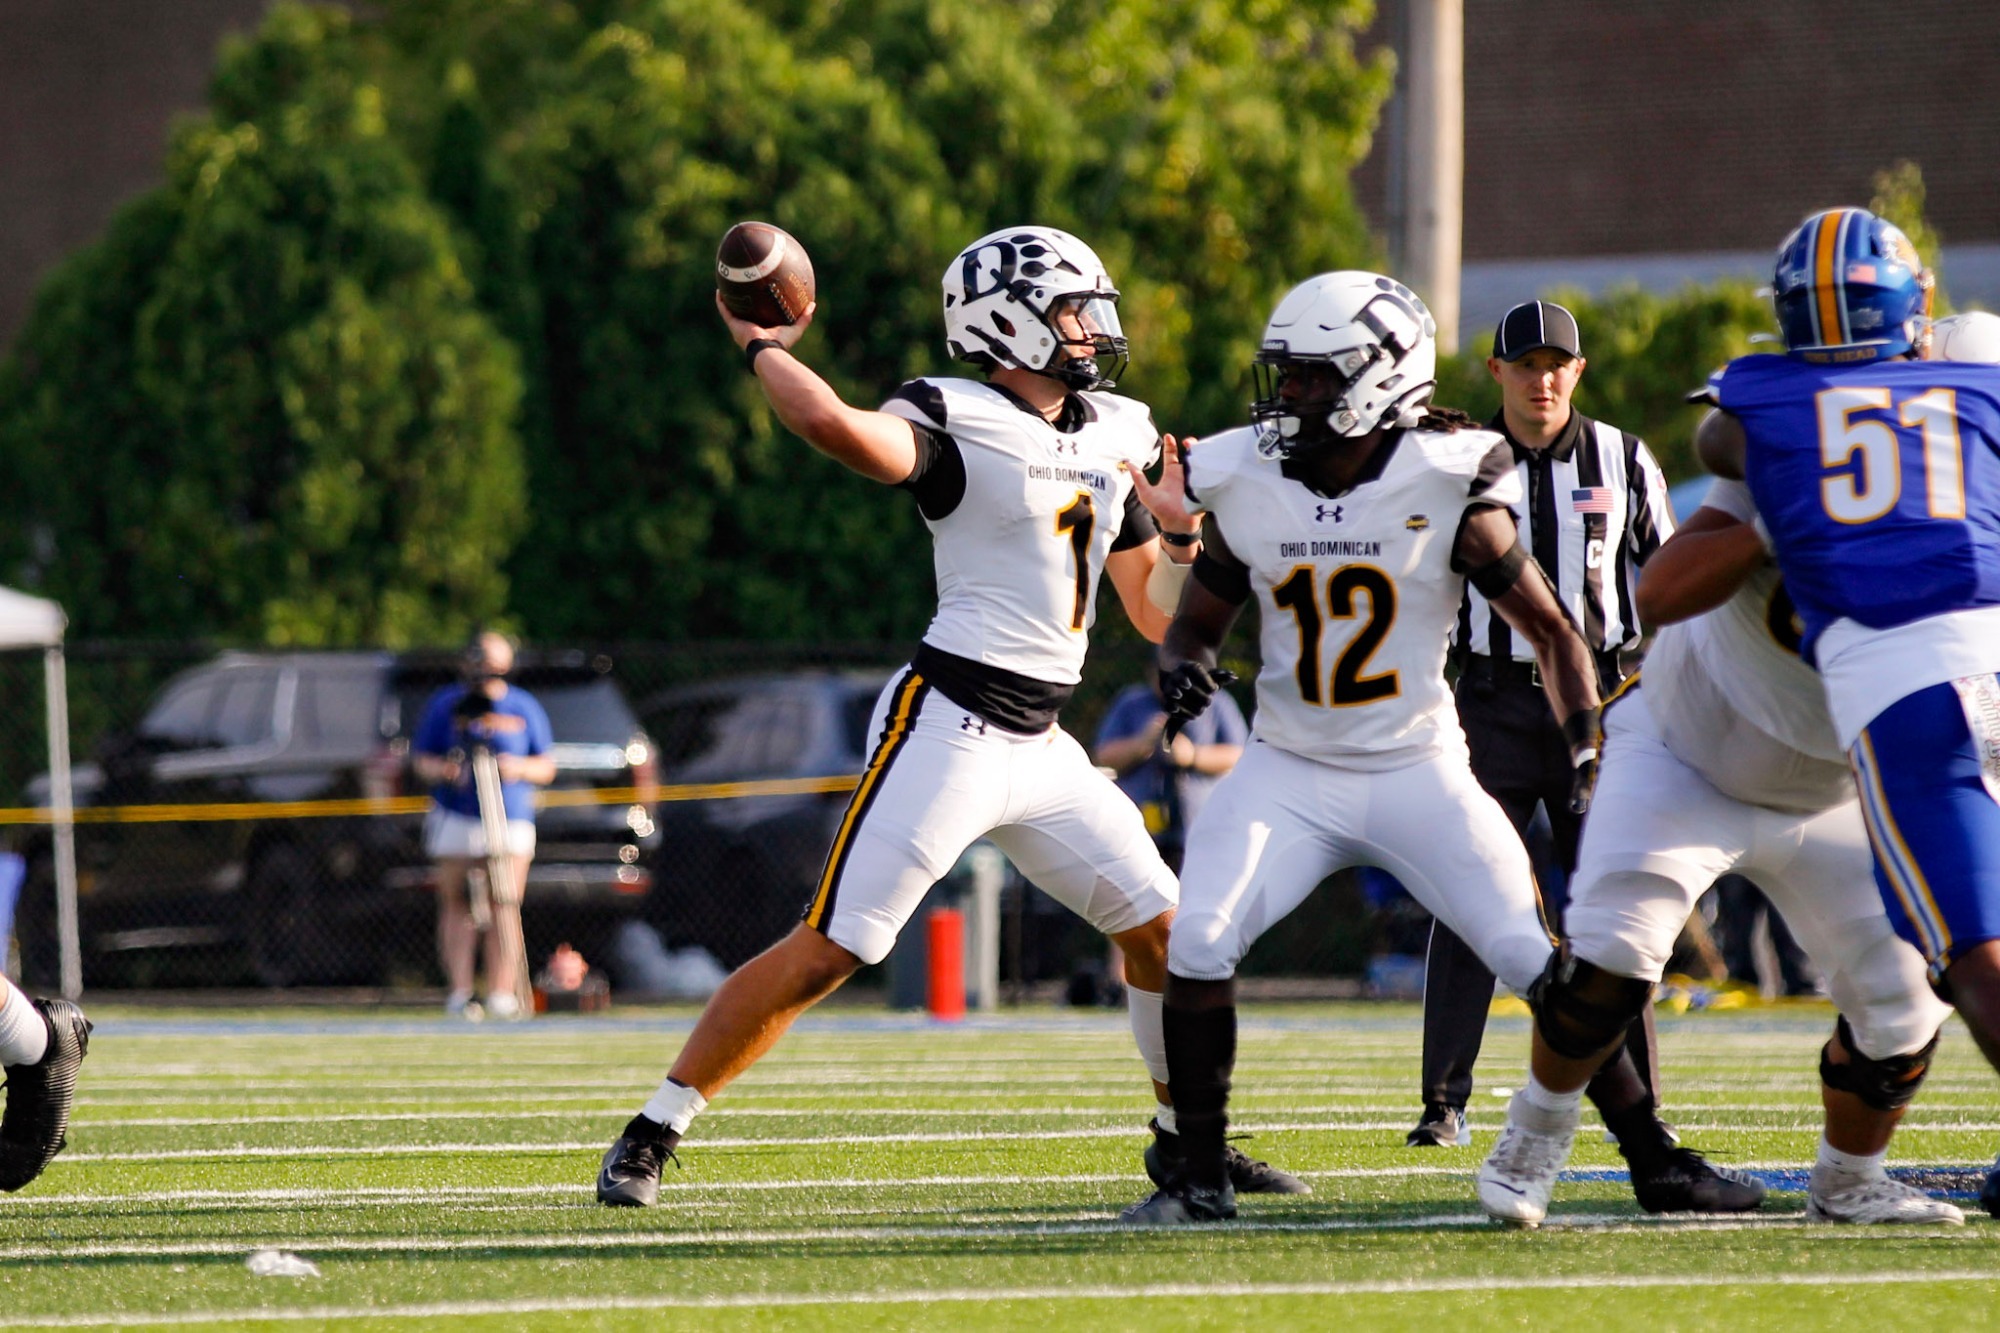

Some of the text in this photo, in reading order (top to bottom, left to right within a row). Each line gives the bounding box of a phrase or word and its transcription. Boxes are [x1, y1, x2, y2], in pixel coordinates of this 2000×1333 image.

[1028, 465, 1107, 491] OHIO DOMINICAN
[1815, 387, 1966, 525] 51
[1054, 490, 1096, 632] 1
[1281, 541, 1381, 558] OHIO DOMINICAN
[1586, 539, 1604, 569] C
[1271, 563, 1402, 709] 12
